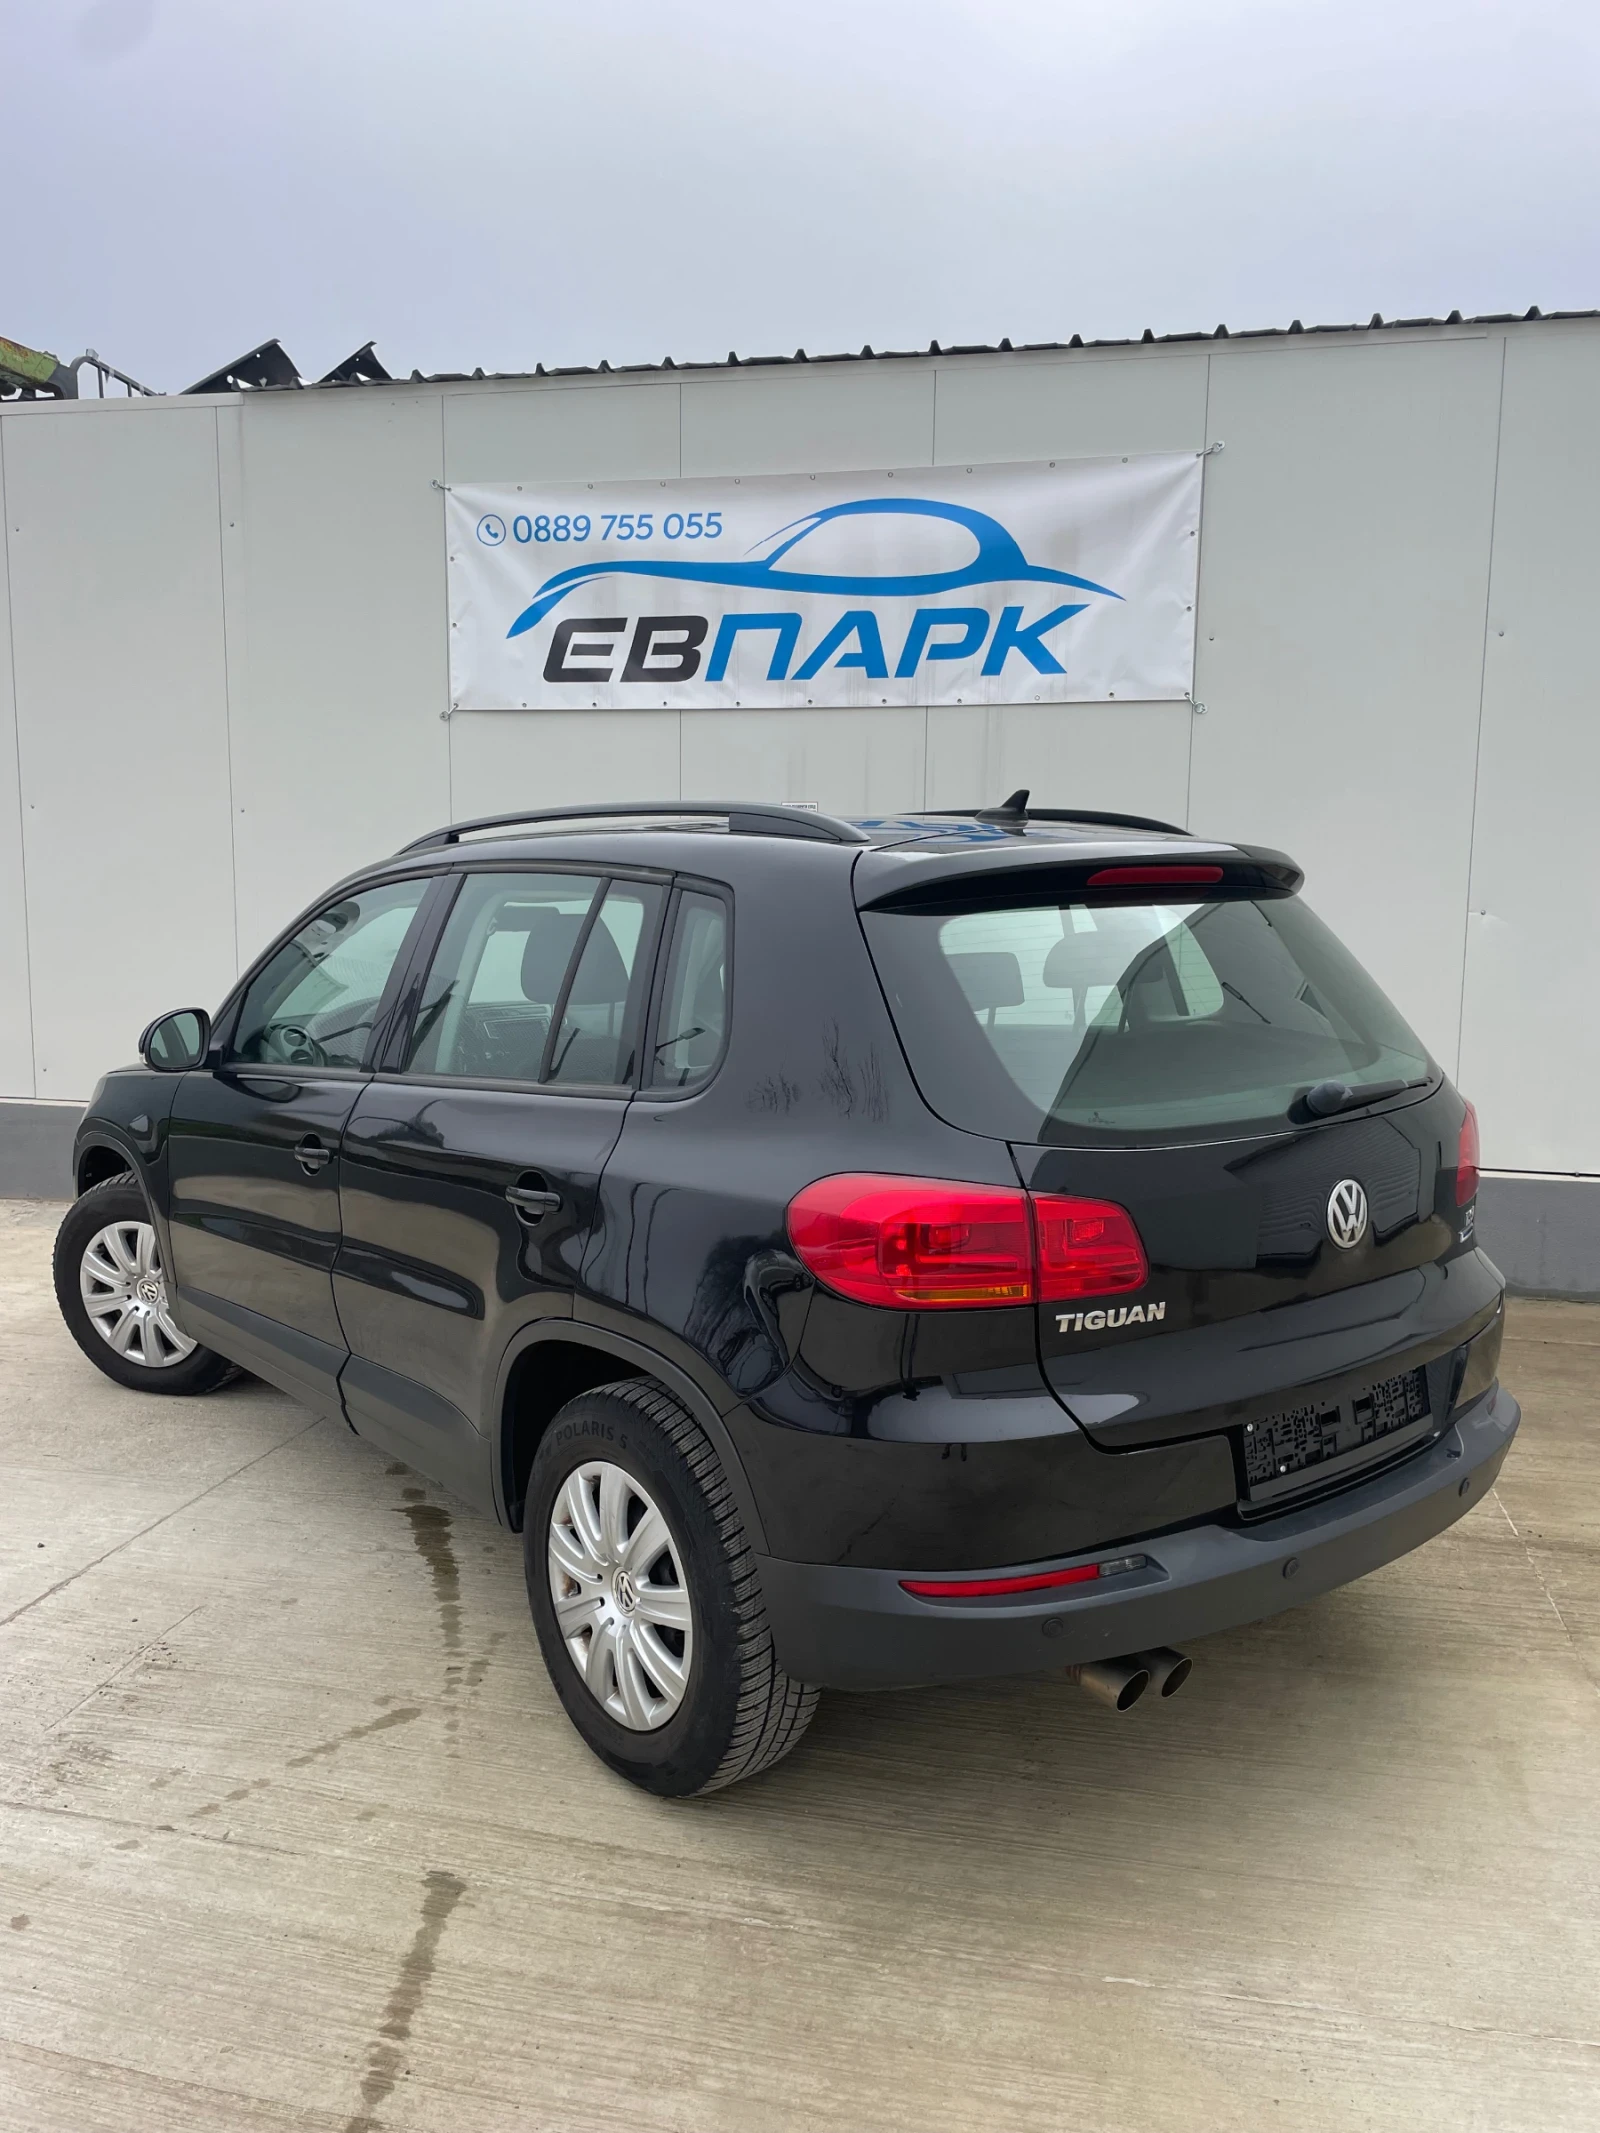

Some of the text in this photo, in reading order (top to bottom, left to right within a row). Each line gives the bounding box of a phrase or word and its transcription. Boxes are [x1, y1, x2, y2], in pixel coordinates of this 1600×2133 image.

[512, 512, 723, 544] 0889 755 055
[542, 603, 1091, 683] ЕВПАРК
[1055, 1302, 1166, 1333] TIGUAN
[555, 1420, 614, 1446] POLARIS
